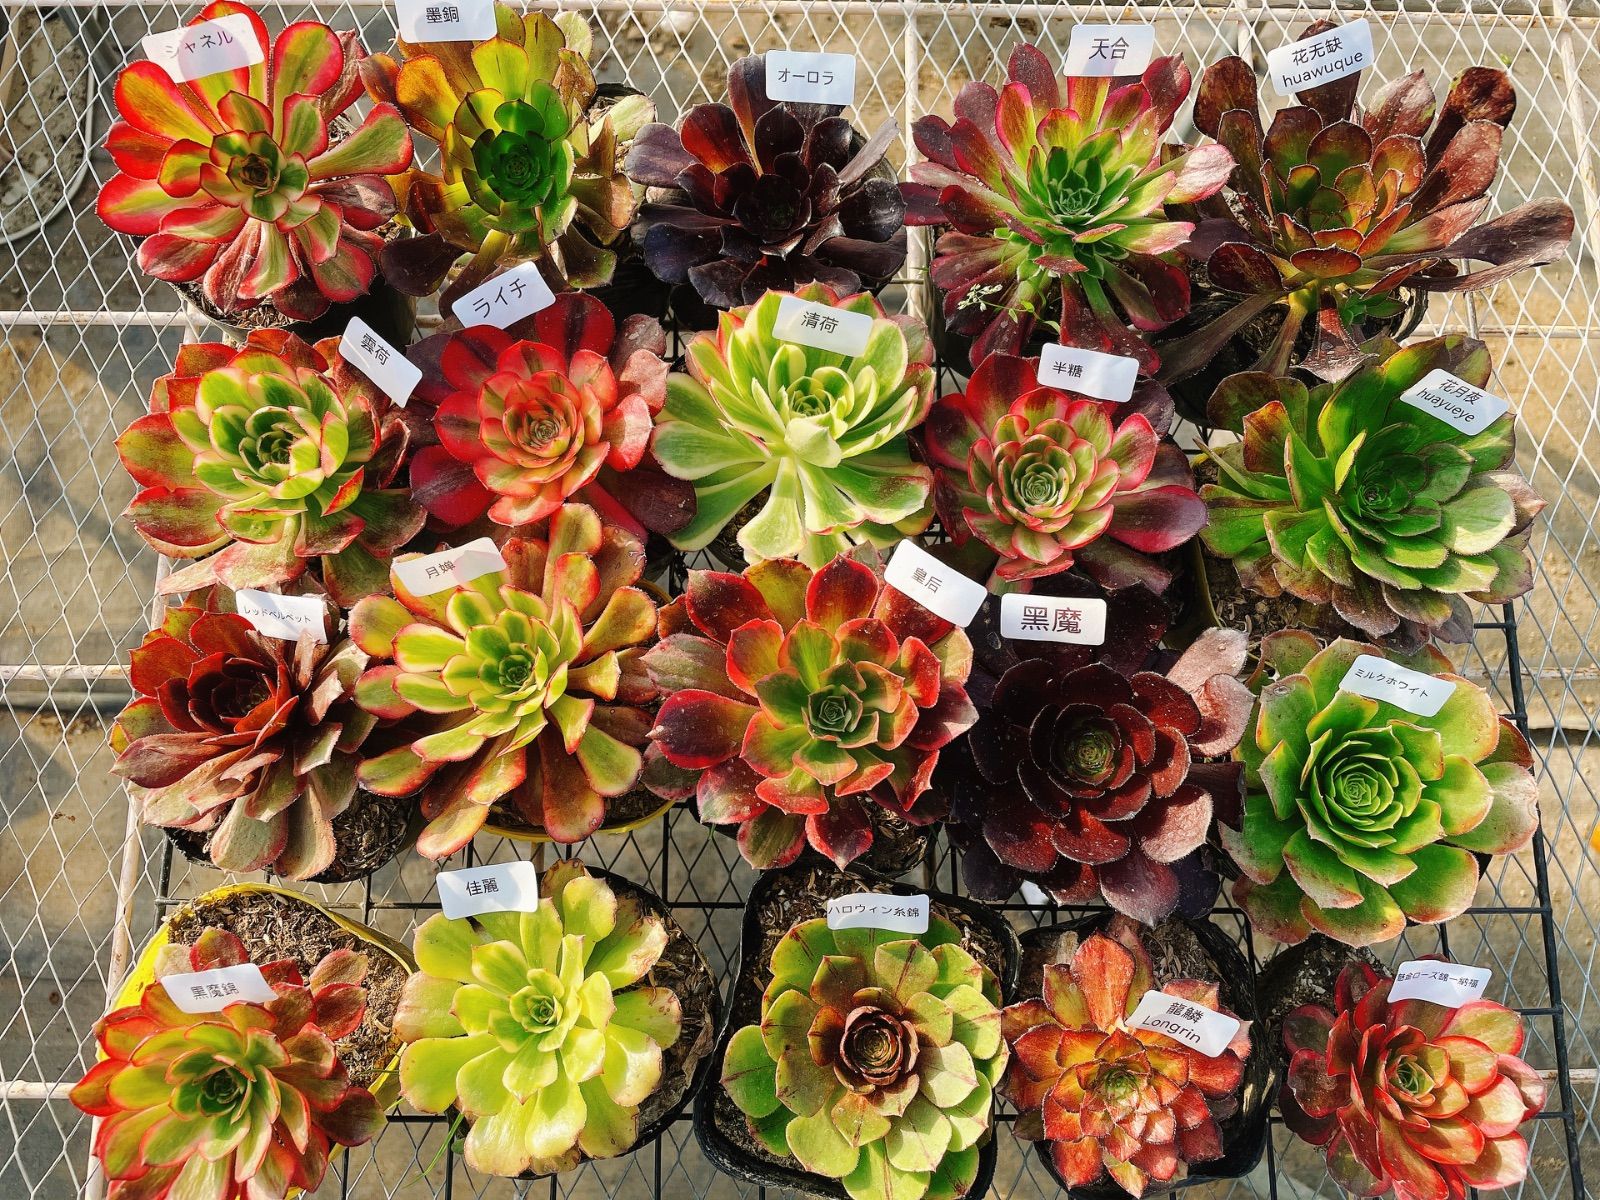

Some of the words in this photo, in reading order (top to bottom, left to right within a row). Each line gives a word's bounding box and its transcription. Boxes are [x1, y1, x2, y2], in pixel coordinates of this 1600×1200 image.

[164, 31, 233, 58] シャネル
[1088, 37, 1130, 60] 天合
[778, 68, 835, 85] オーロラ
[1282, 51, 1364, 87] huawuque
[472, 277, 527, 318] ライチ
[800, 311, 840, 334] 清荷
[360, 333, 391, 366] 雲荷
[1052, 361, 1084, 378] 半糖
[1416, 387, 1475, 423] huayueye
[1439, 379, 1483, 405] 花月夜
[911, 567, 943, 593] 皇后
[1354, 668, 1429, 699] ミルクホワイト
[466, 876, 500, 897] 佳麗
[828, 904, 920, 918] ハロウィン糸錦
[1142, 1015, 1202, 1044] Longrin
